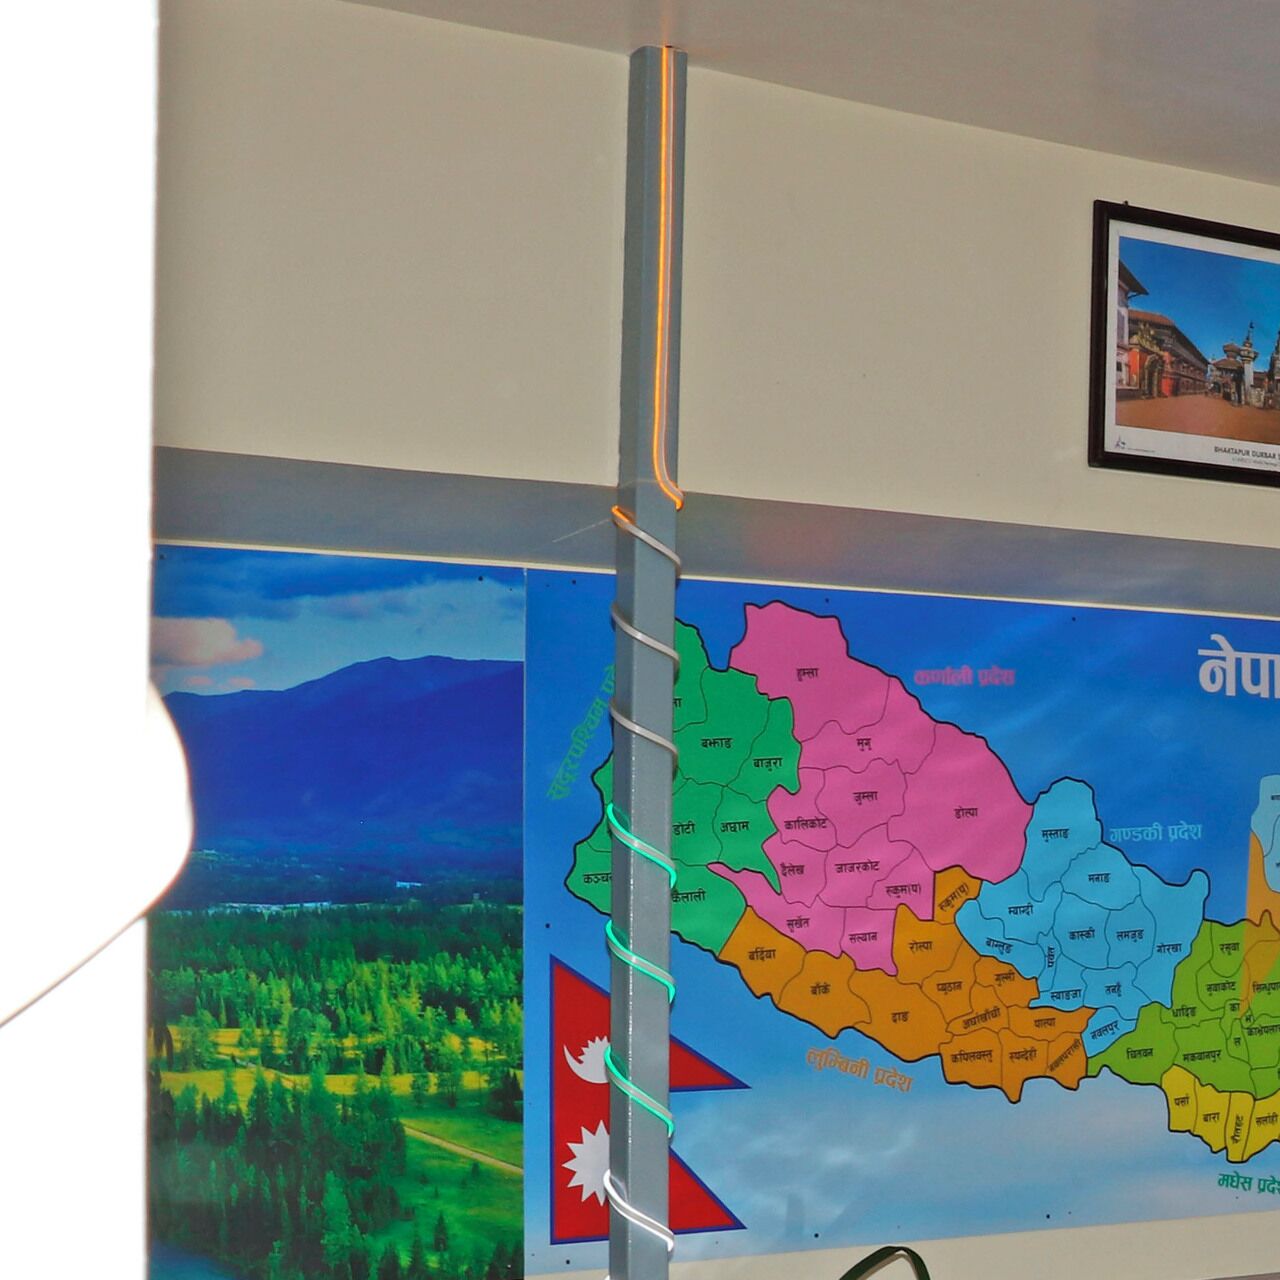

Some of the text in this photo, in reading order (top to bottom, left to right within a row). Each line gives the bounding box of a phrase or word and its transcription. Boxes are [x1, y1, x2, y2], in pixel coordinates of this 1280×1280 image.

[1214, 445, 1250, 457] BHAKTAPUR
[1251, 450, 1276, 460] DURBAR
[1109, 820, 1202, 842] गण्डकी प्रदेश
[807, 1047, 913, 1092] लुम्बिनी प्रदेश
